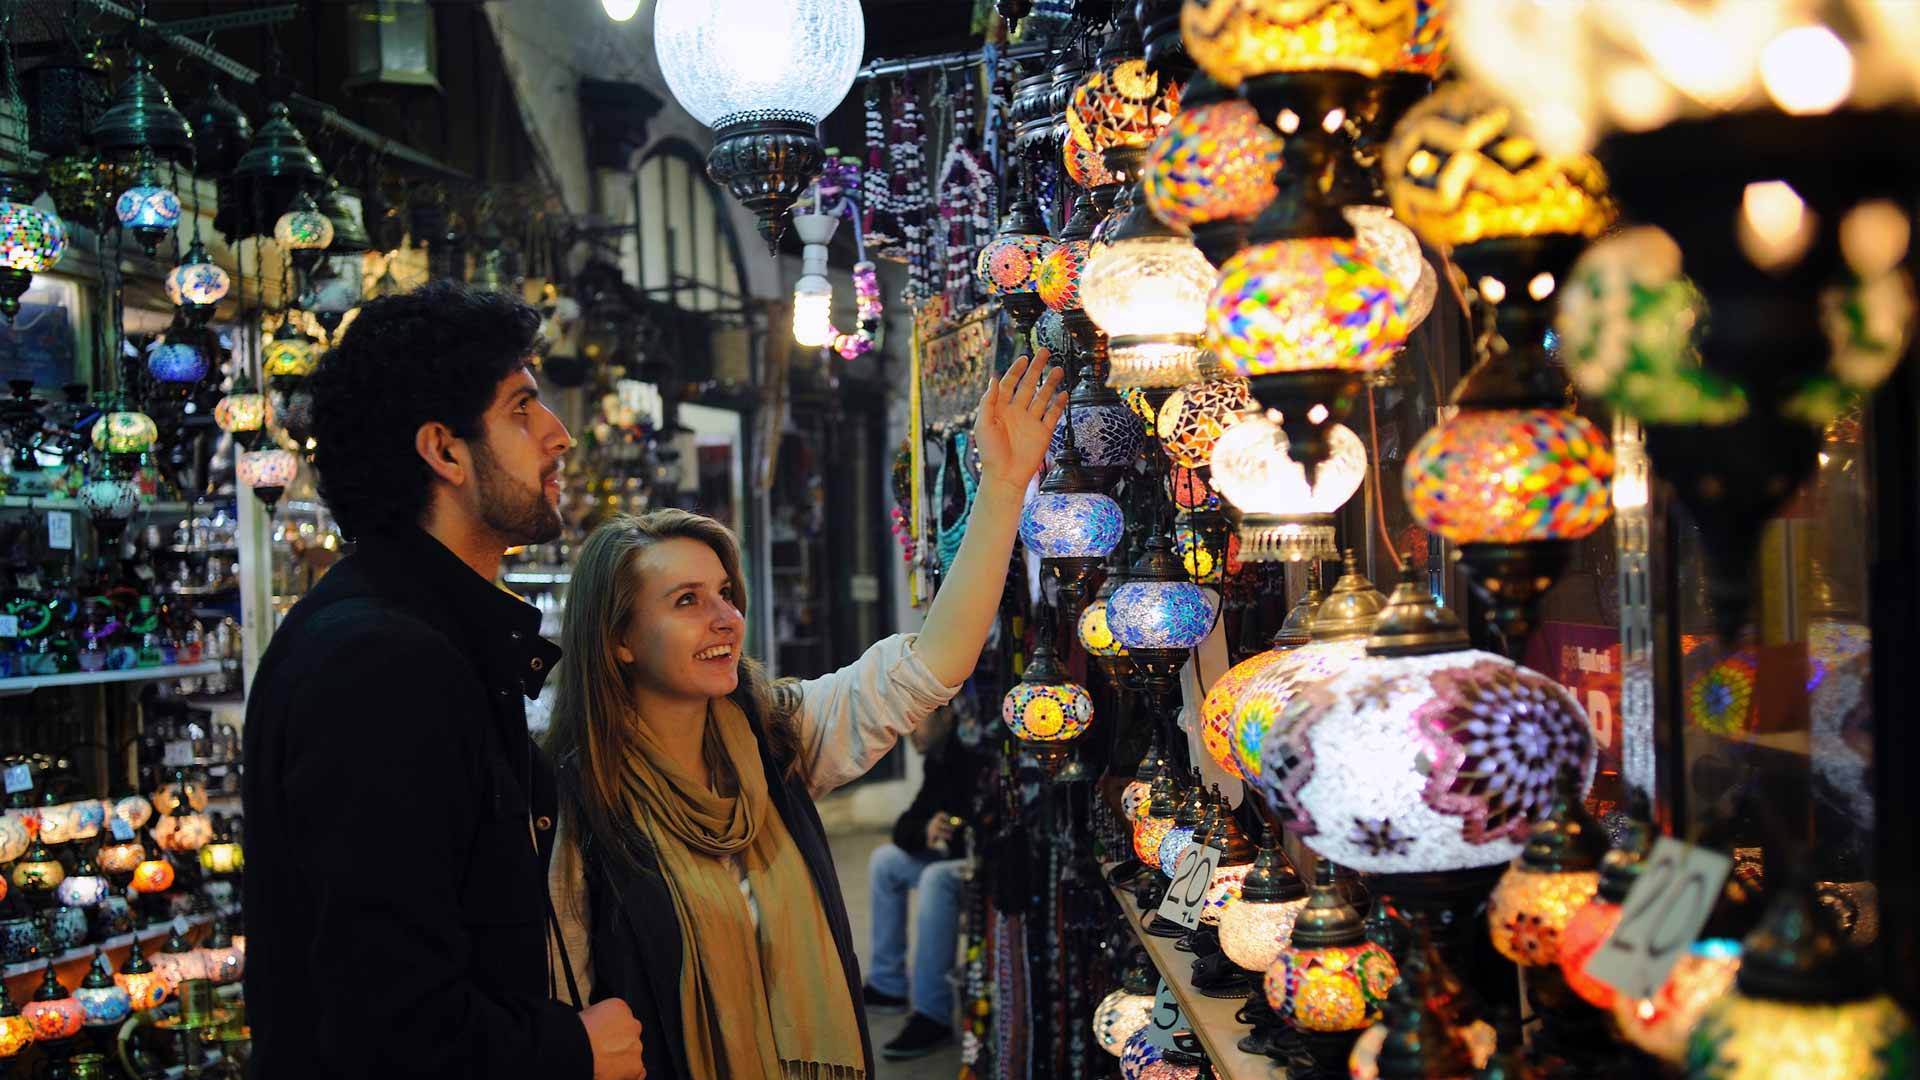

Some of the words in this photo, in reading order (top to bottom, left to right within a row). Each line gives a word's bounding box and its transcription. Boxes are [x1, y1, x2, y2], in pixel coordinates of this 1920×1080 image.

[1167, 850, 1210, 907] 20
[1612, 856, 1707, 957] 20
[1181, 911, 1194, 923] TL
